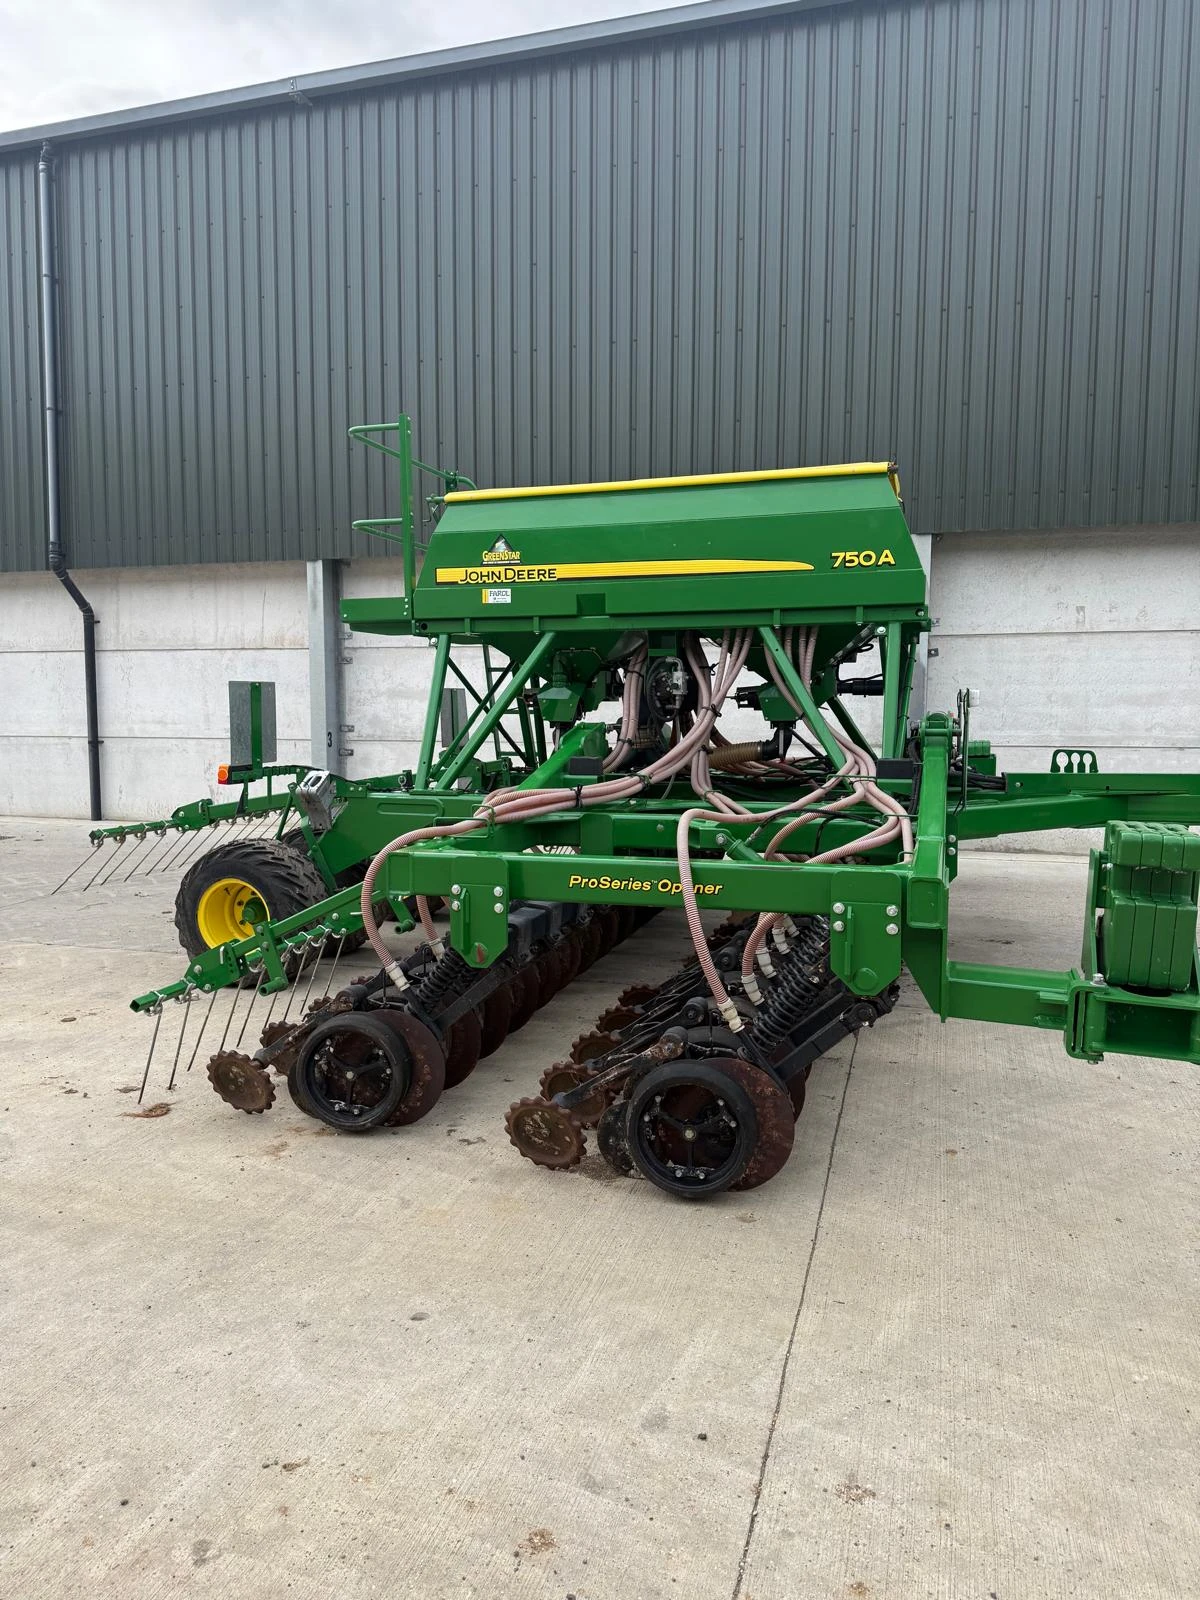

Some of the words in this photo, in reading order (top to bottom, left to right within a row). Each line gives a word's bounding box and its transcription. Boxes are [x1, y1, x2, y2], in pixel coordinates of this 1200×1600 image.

[831, 549, 896, 568] 750A
[459, 569, 502, 582] JOHN
[504, 567, 557, 581] DEERE
[327, 731, 333, 748] 3
[657, 879, 723, 895] Opner
